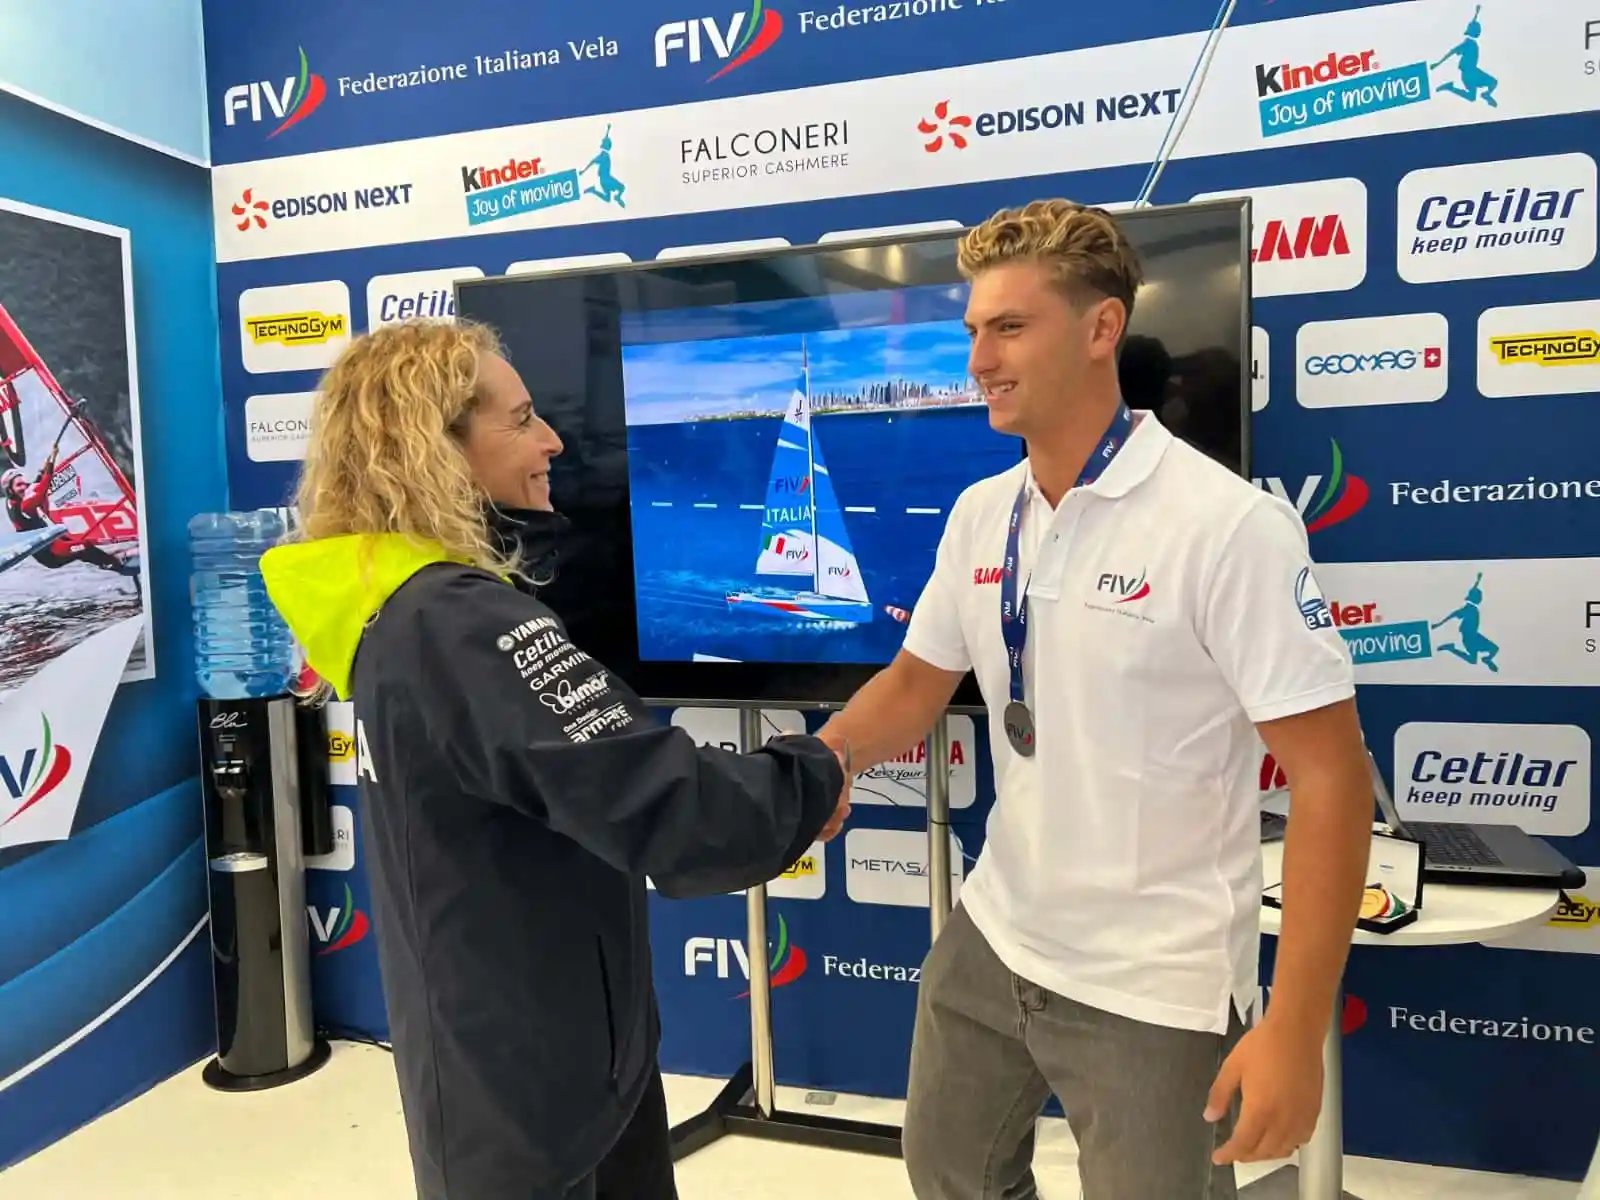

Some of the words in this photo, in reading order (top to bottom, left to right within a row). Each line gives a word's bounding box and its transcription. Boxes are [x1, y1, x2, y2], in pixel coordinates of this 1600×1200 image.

[654, 11, 746, 68] FIV
[338, 61, 467, 97] Federazione
[475, 50, 560, 76] Italiana
[567, 37, 619, 61] Vela
[224, 76, 296, 126] FIV
[1268, 103, 1307, 126] Joy
[1313, 91, 1335, 115] of
[1342, 77, 1420, 109] moving
[681, 120, 848, 163] FALCONERI
[682, 164, 758, 184] SUPERIOR
[765, 153, 849, 175] CASHMERE
[471, 198, 499, 218] Joy
[501, 190, 518, 209] of
[520, 179, 573, 203] moving
[1416, 187, 1584, 232] Cetilar
[1411, 236, 1467, 255] keep
[1476, 226, 1564, 248] moving
[1305, 350, 1417, 376] GEOMAG
[775, 477, 799, 493] FIV
[1390, 477, 1600, 505] Federazione
[766, 505, 811, 522] ITALIA
[786, 550, 802, 560] FIV
[828, 567, 844, 576] FIV
[1097, 573, 1137, 596] FIV
[1411, 750, 1578, 788] Cetilar
[1407, 786, 1461, 806] keep
[1470, 790, 1558, 812] moving
[1388, 1006, 1595, 1044] Federazione
